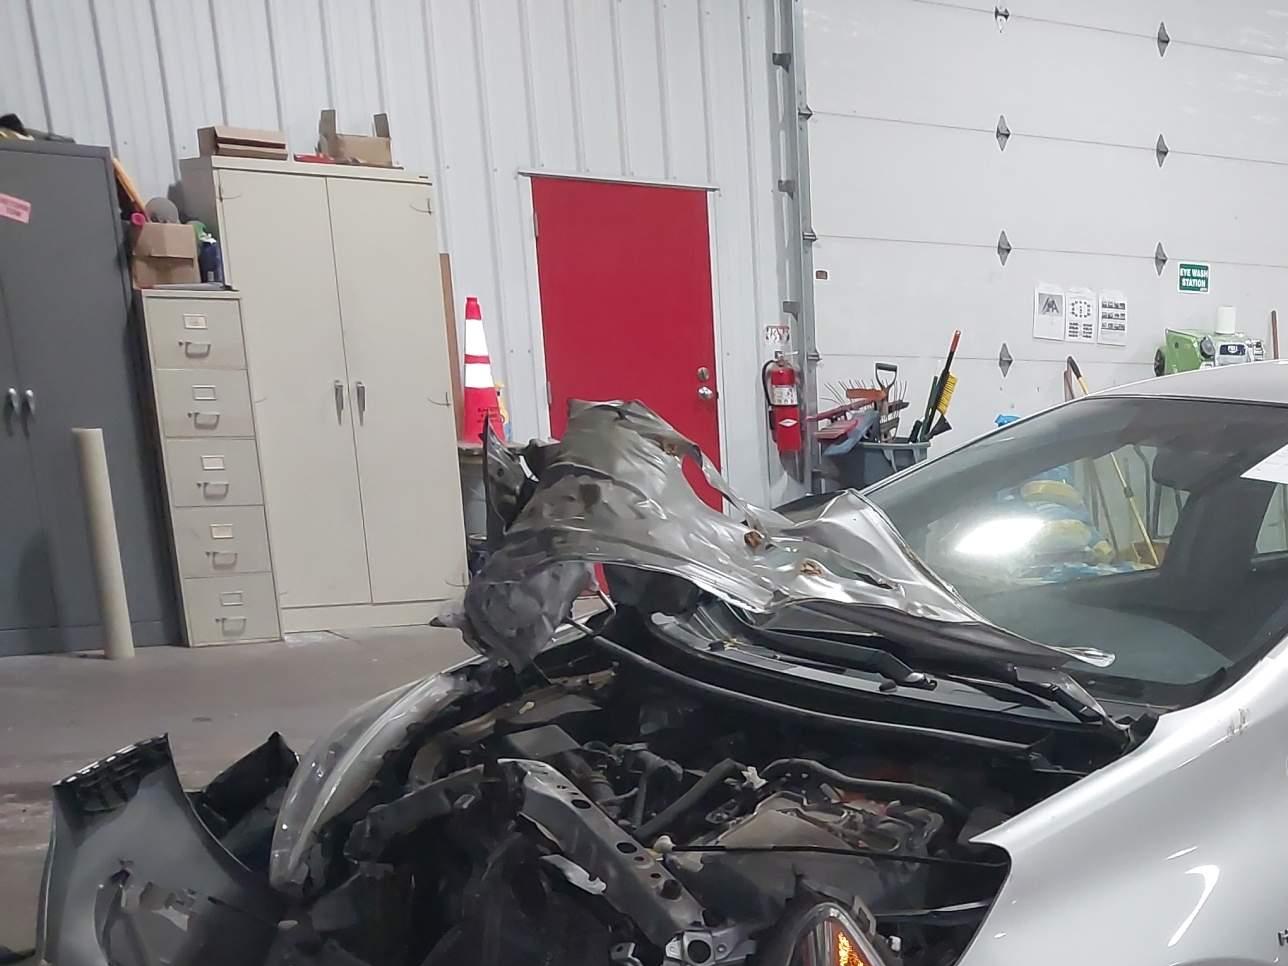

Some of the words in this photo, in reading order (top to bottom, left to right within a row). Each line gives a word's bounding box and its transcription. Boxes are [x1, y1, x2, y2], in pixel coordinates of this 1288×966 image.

[1180, 268, 1191, 277] EYE
[1192, 269, 1209, 279] WASH
[1181, 278, 1206, 288] STATION
